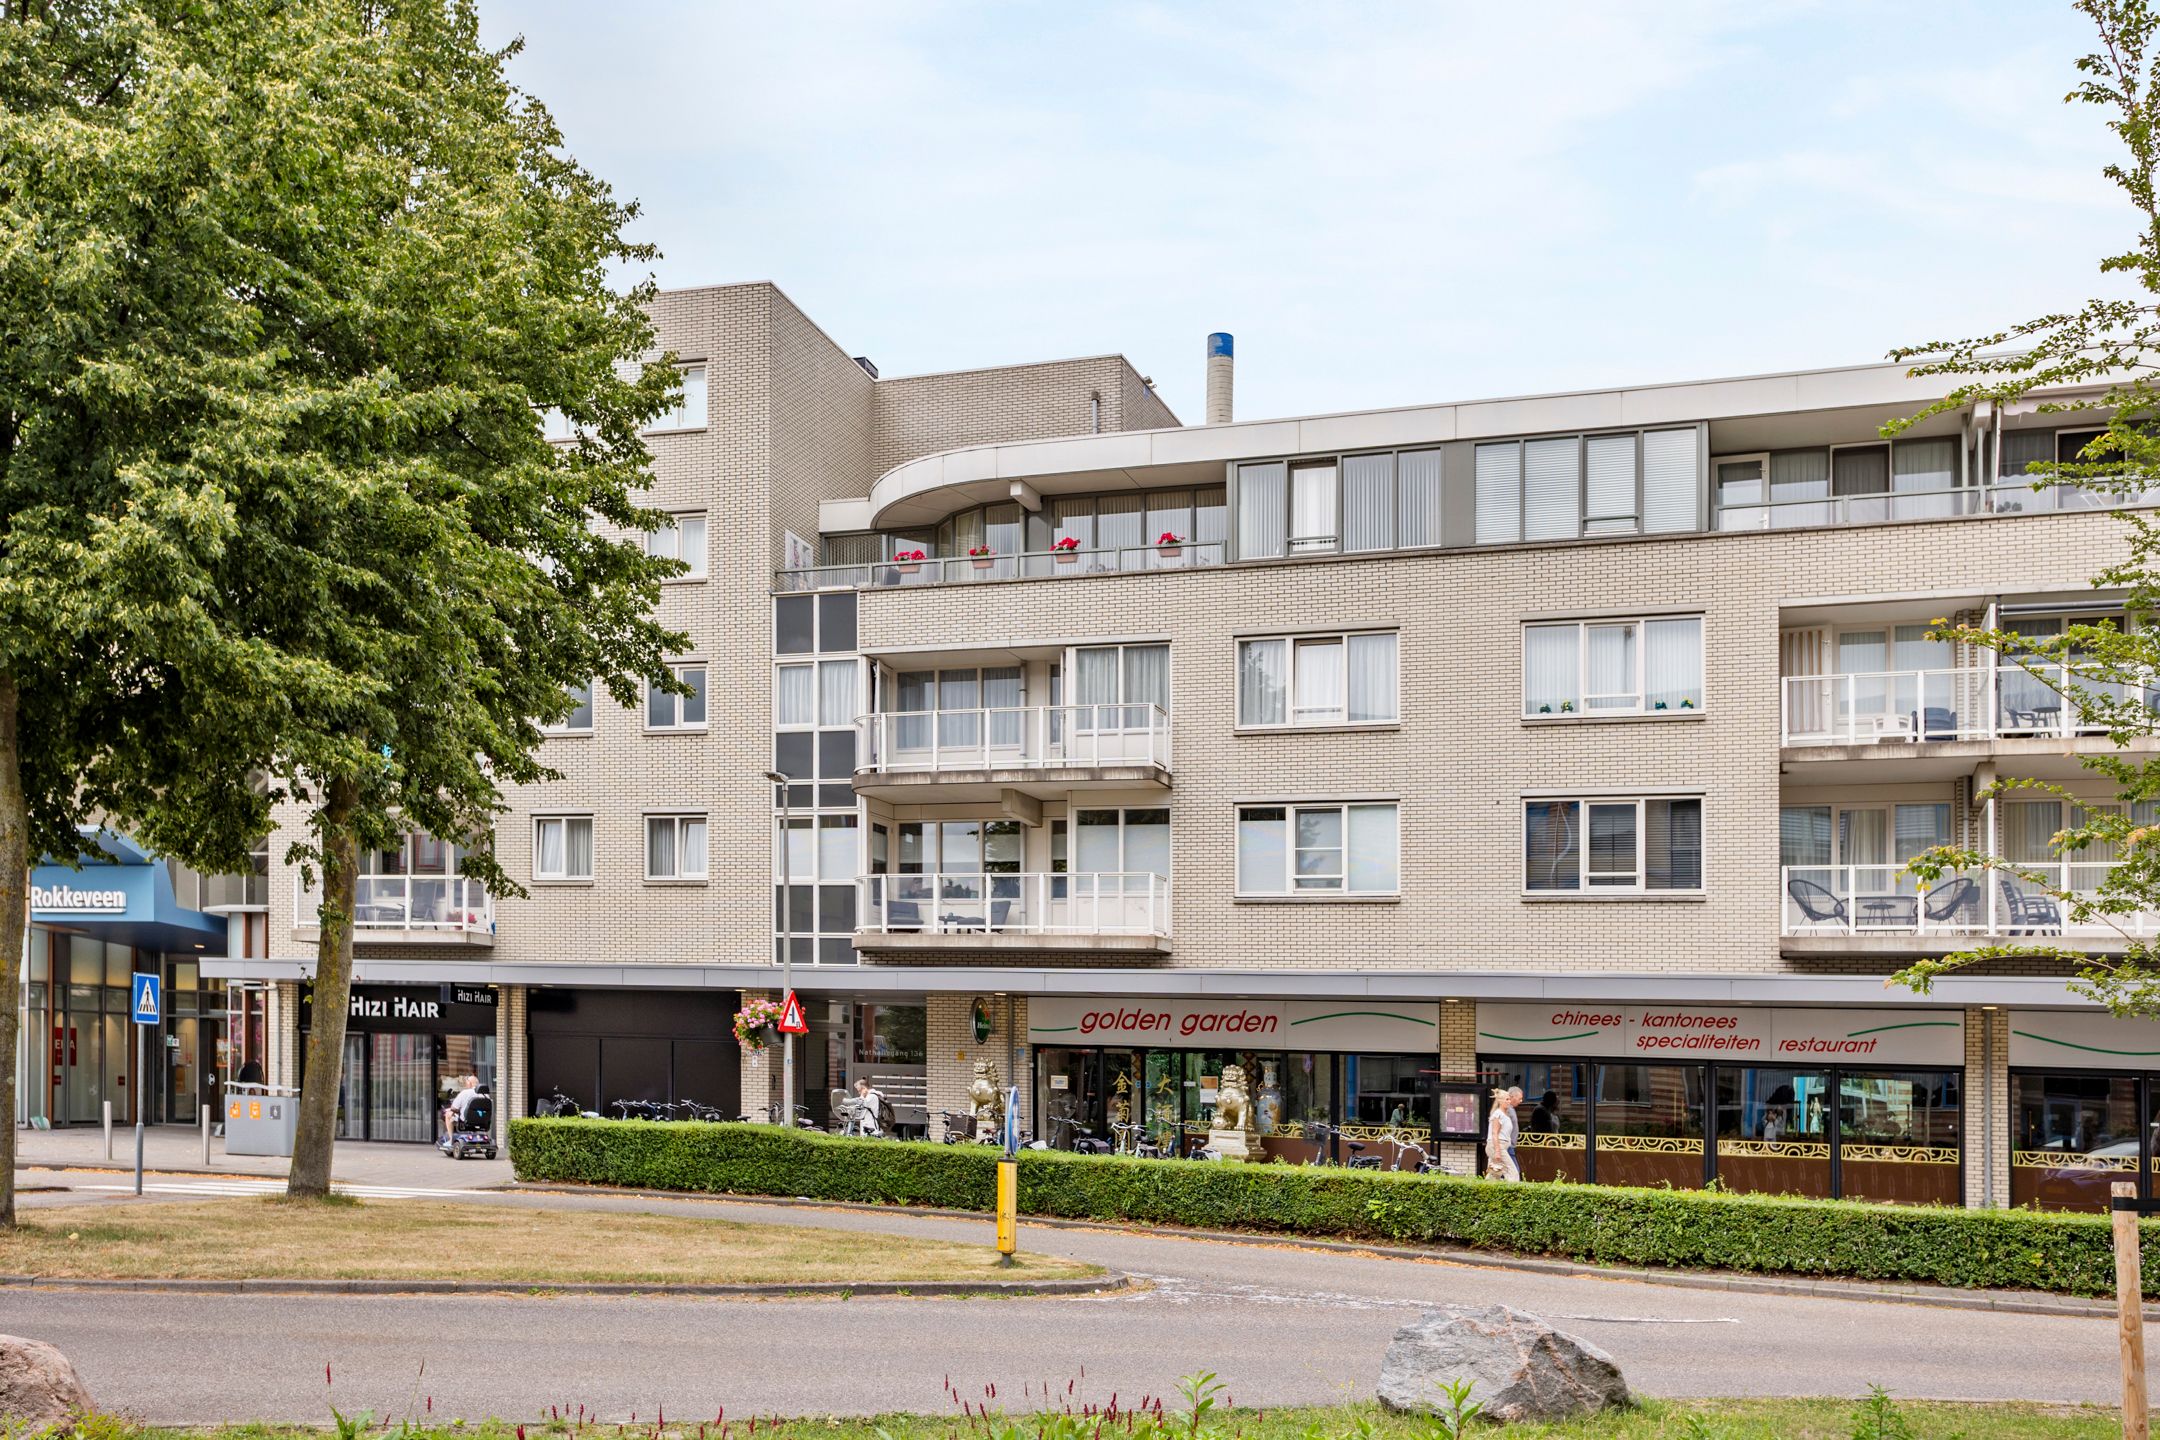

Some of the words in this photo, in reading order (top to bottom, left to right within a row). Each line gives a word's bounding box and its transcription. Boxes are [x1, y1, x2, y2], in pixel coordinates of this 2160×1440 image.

[31, 885, 126, 907] Rokkeveen
[458, 989, 473, 1002] HIZI
[475, 991, 492, 1004] HAIR
[351, 996, 387, 1017] HIZI
[394, 997, 439, 1018] HAIR
[1080, 1008, 1171, 1034] golden
[1180, 1010, 1278, 1036] garden
[1551, 1011, 1622, 1026] chinees
[1641, 1012, 1738, 1029] kantonees
[1636, 1034, 1760, 1051] specialiteiten
[1778, 1037, 1877, 1053] restaurant
